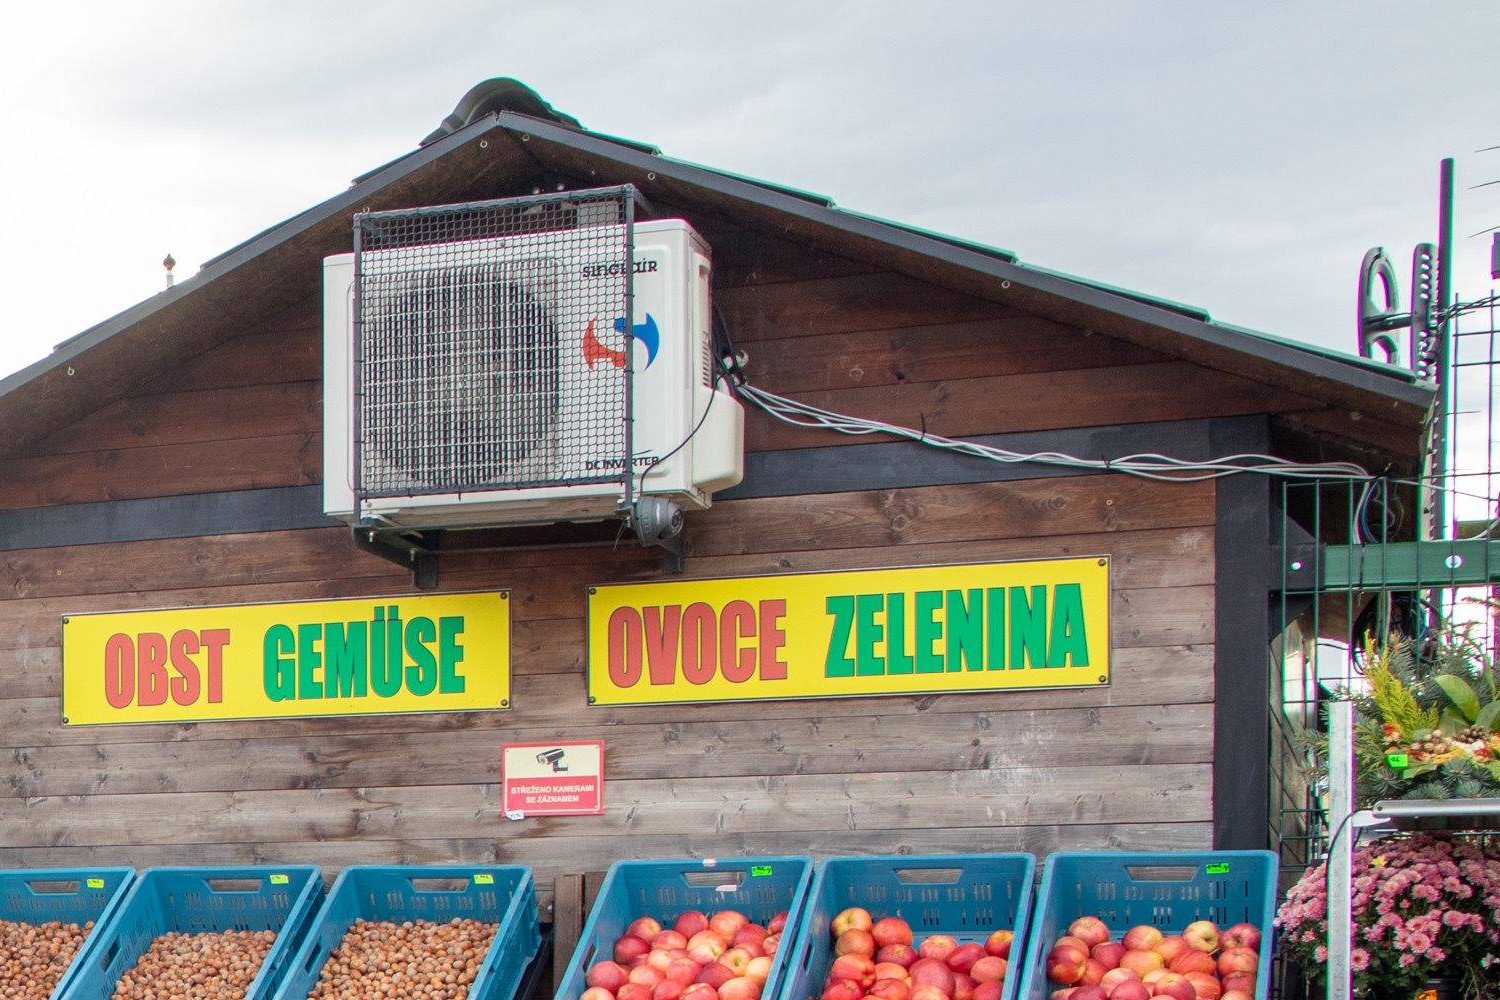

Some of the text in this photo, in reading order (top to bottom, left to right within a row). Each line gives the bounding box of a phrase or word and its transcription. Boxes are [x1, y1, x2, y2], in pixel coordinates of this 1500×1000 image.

[104, 605, 466, 709] OBST GEMÜSE
[607, 583, 1089, 689] OVOCE ZELENINA
[525, 794, 579, 804] SE ZÁZNAMEM
[552, 785, 594, 794] KAMERAMI
